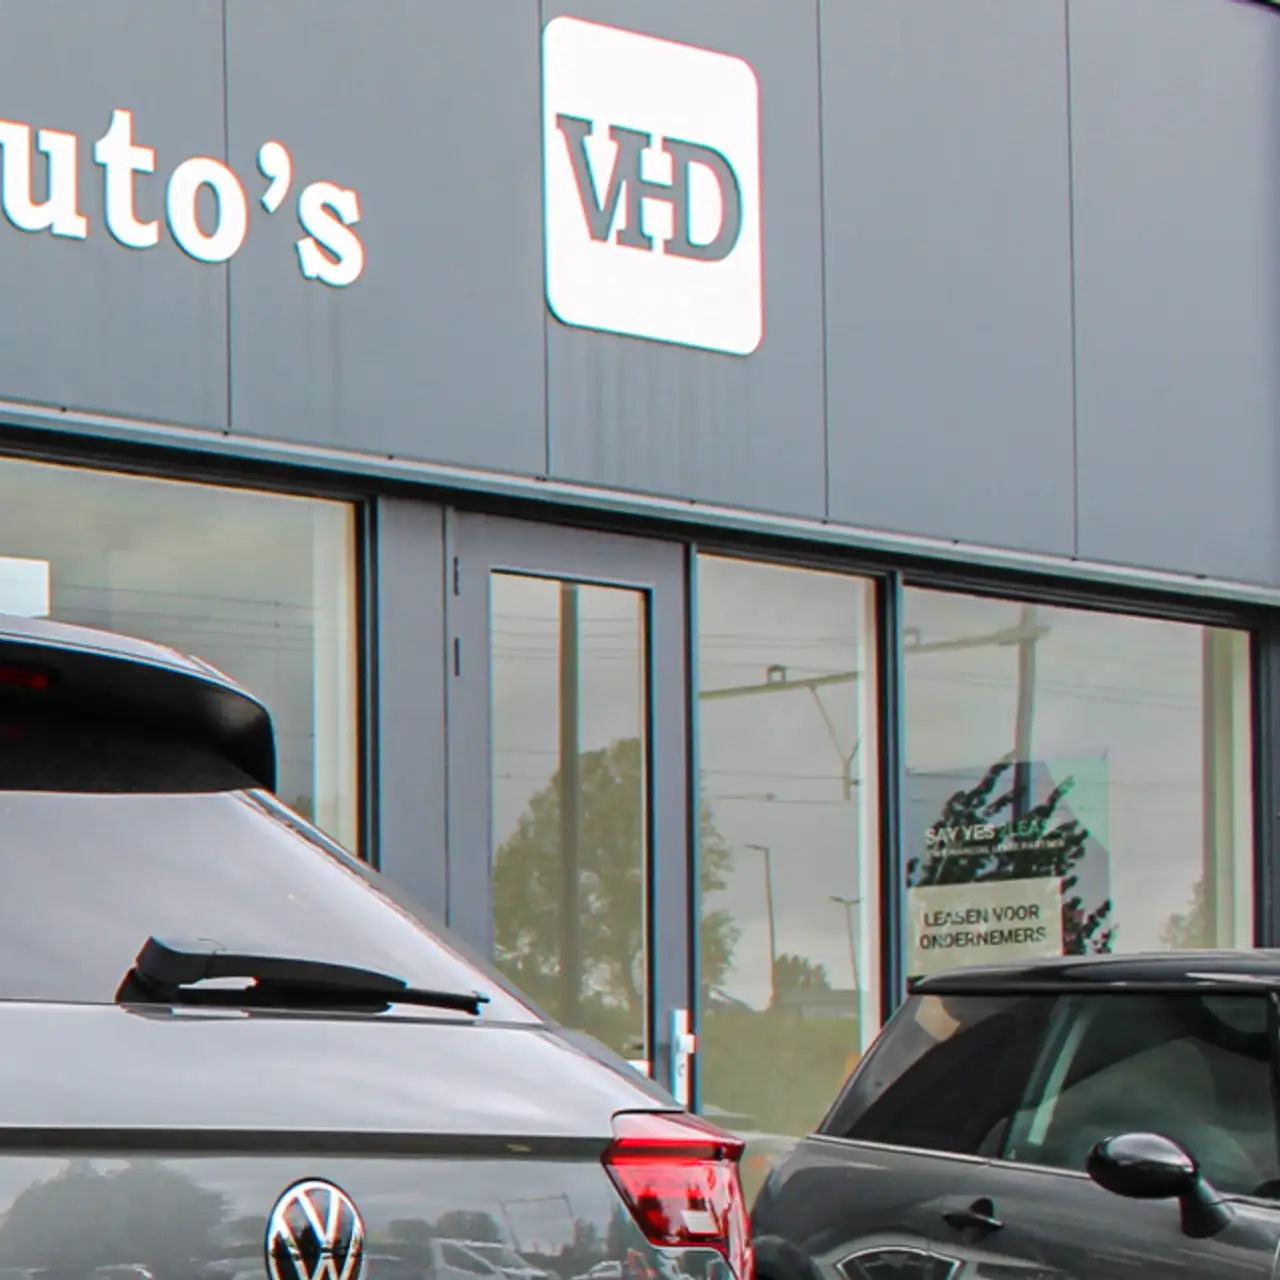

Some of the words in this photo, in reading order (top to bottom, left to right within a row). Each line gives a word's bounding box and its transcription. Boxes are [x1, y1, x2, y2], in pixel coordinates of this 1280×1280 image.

[556, 113, 743, 263] VHD
[962, 823, 996, 842] YES
[924, 908, 988, 927] LEASEN
[993, 904, 1040, 923] VOOR
[919, 926, 1047, 950] ONDERNEMERS
